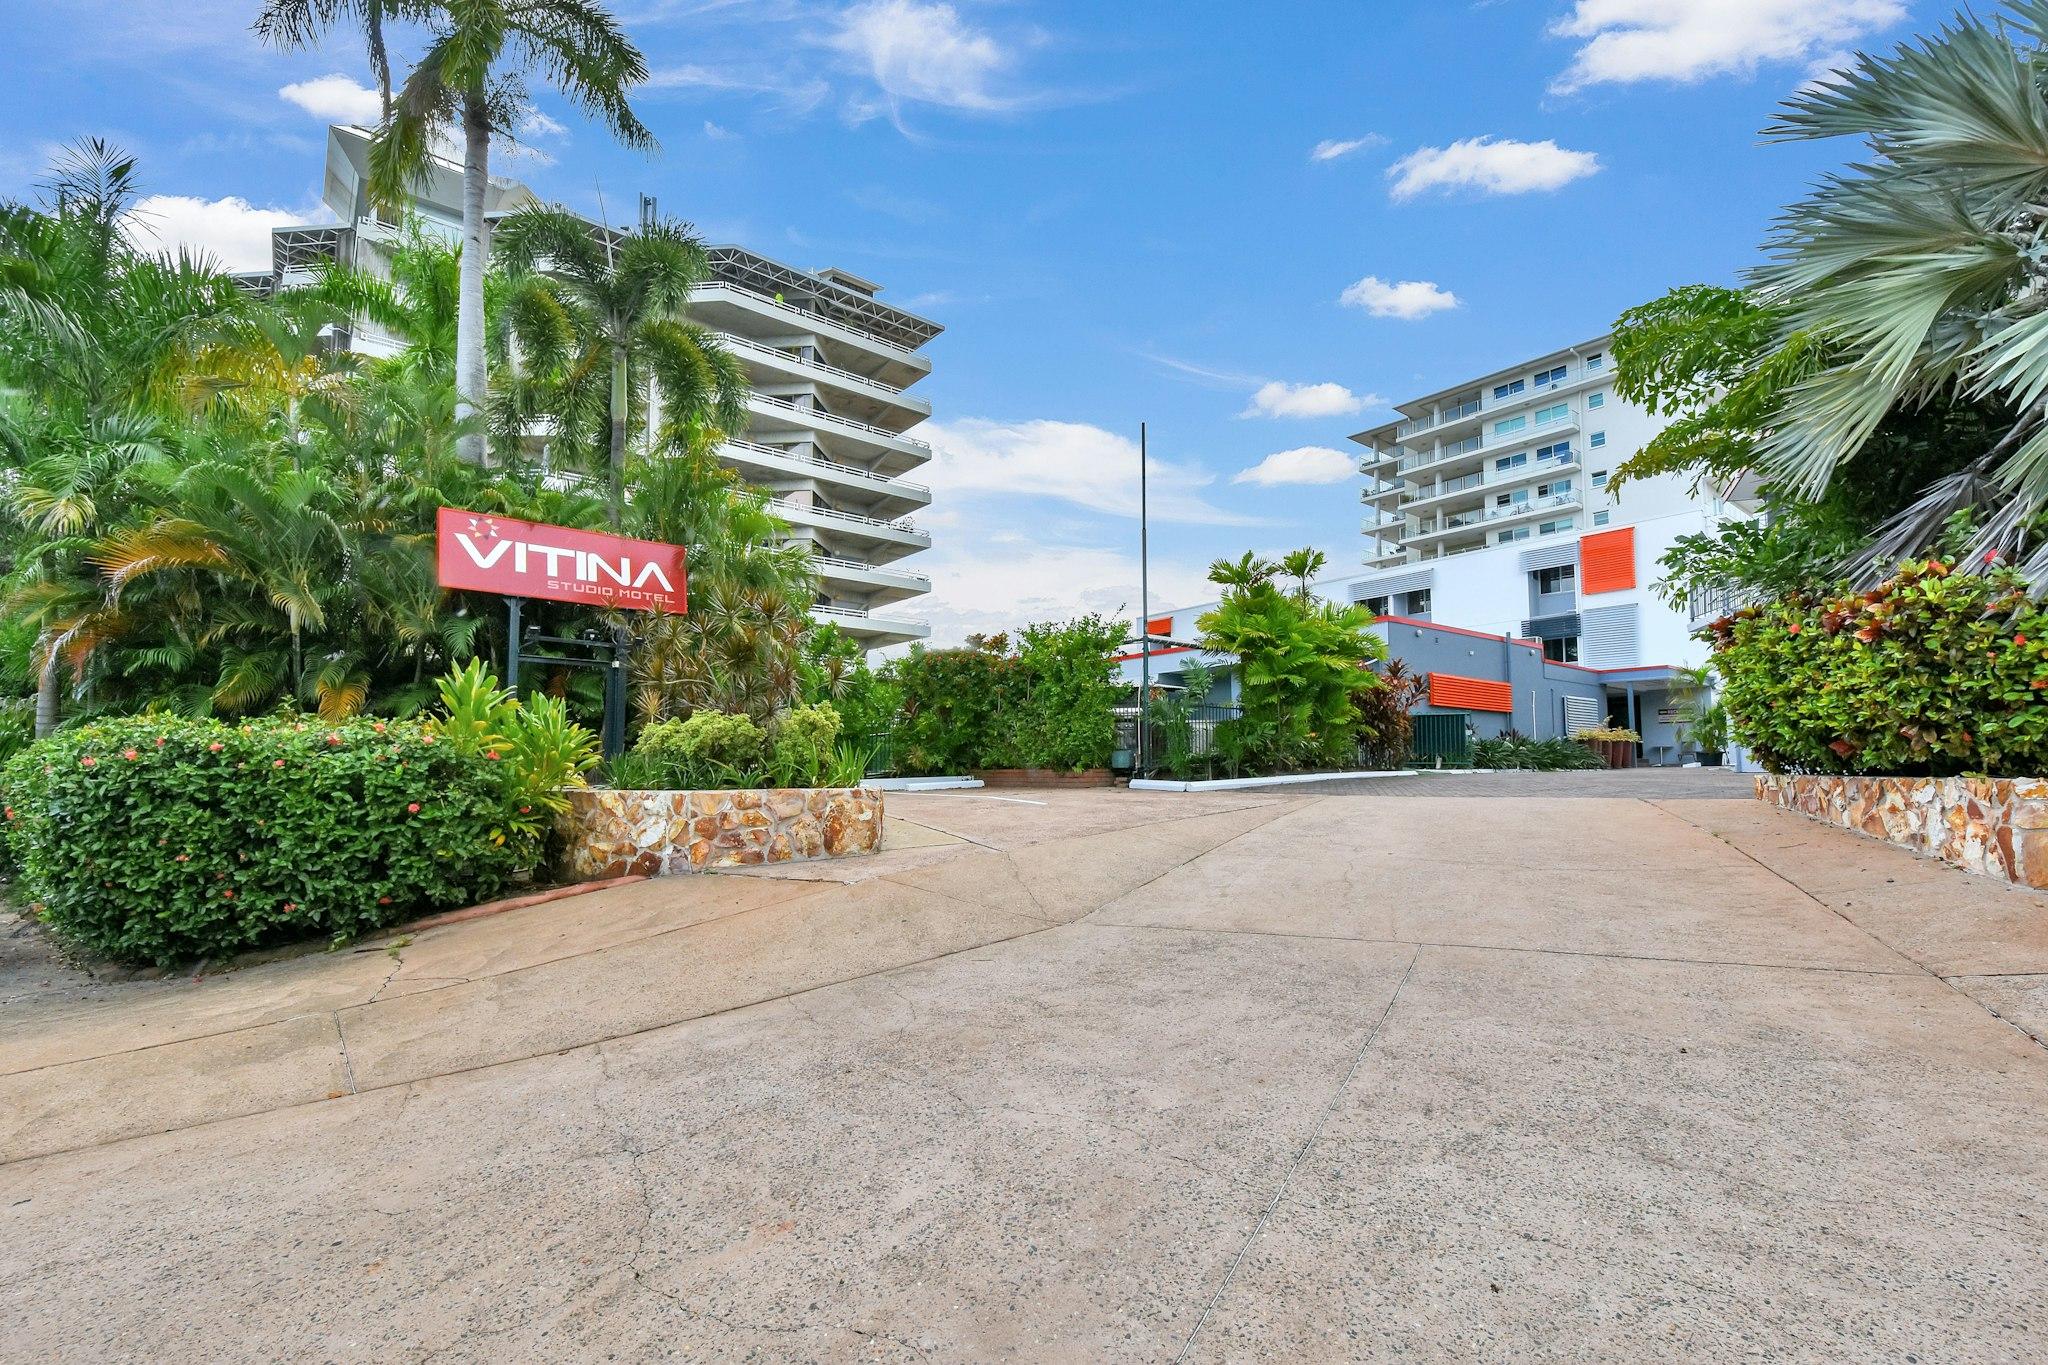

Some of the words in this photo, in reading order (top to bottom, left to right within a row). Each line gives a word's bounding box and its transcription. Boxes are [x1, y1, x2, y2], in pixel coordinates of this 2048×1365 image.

[454, 532, 674, 592] VITINA
[547, 580, 613, 597] STUDIO
[619, 589, 675, 604] MOTEL
